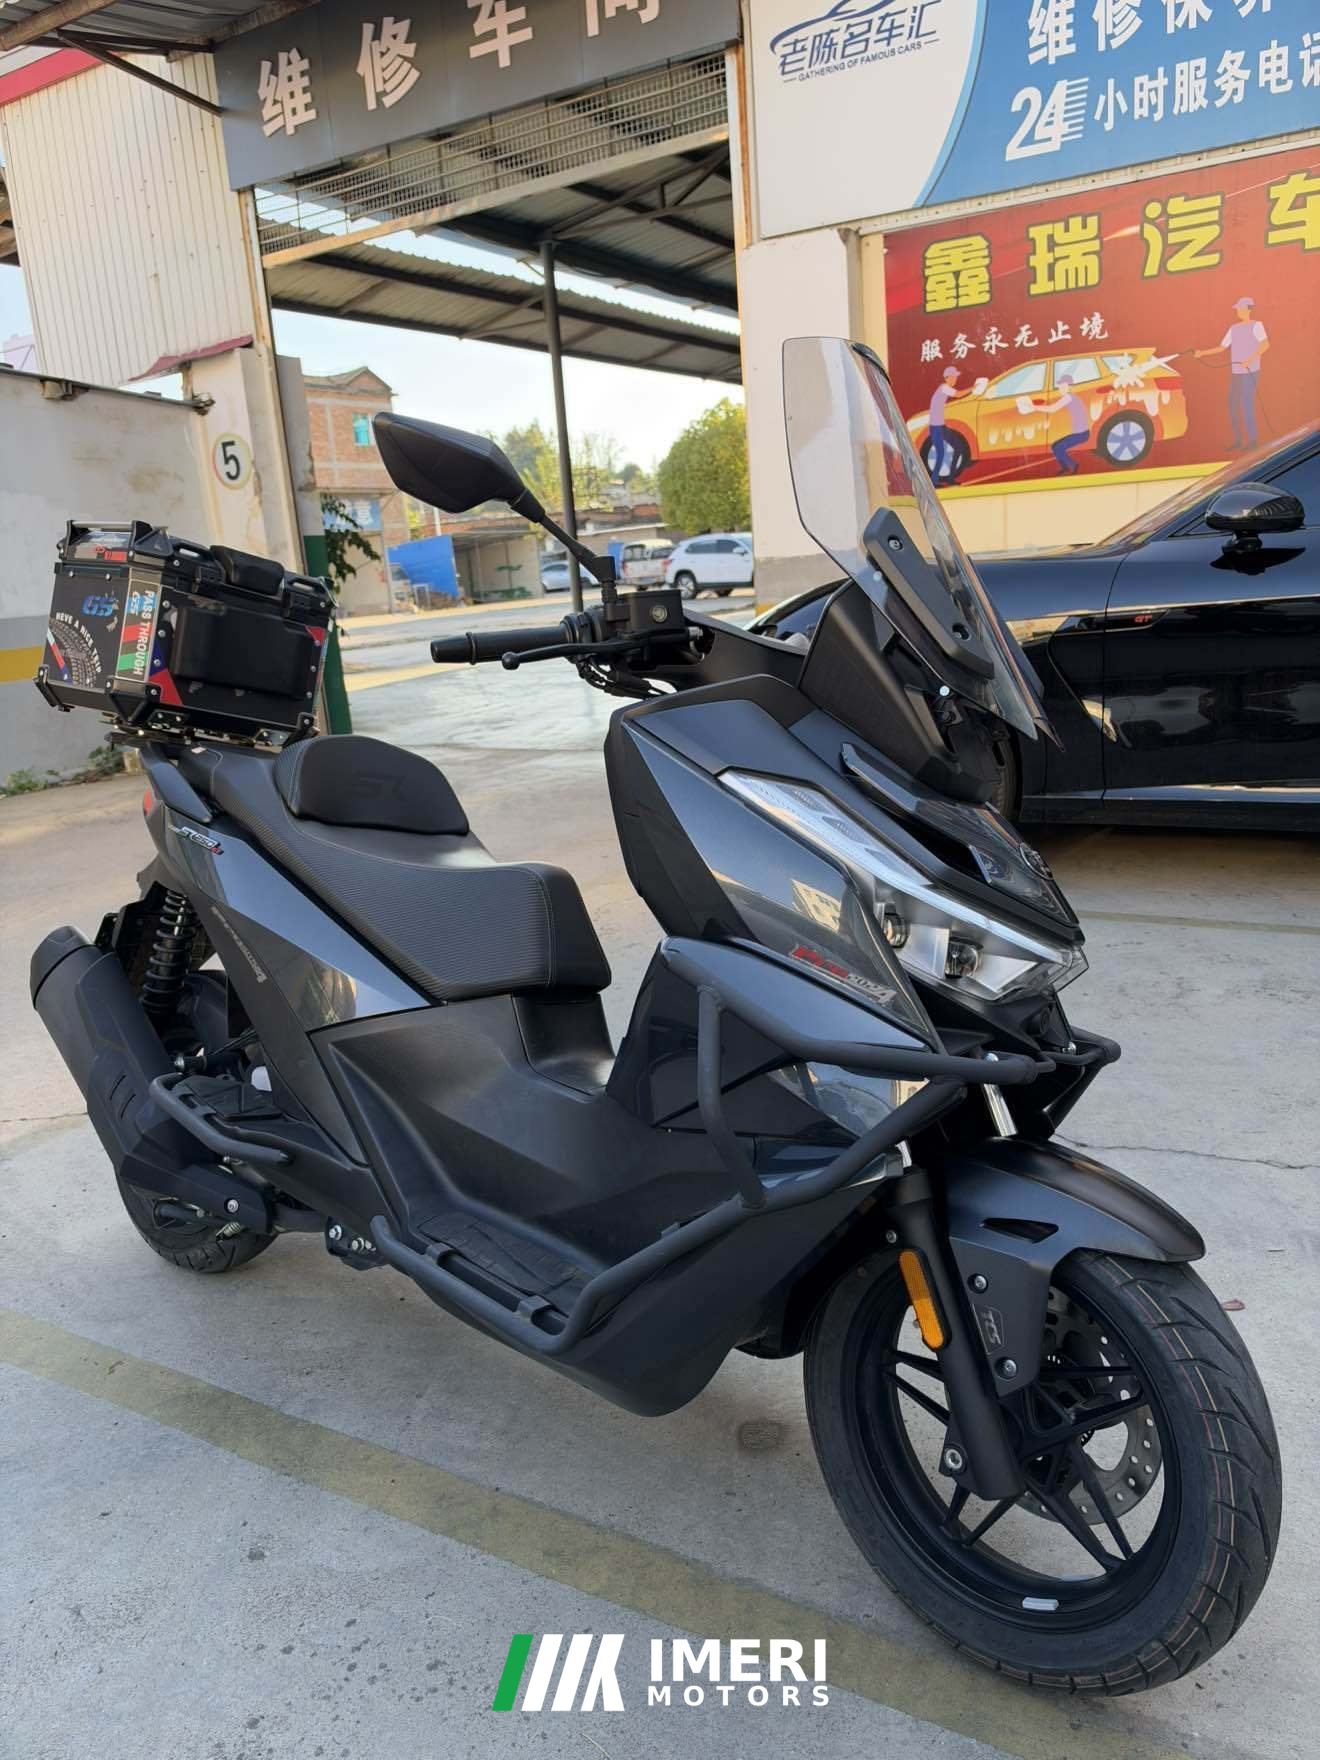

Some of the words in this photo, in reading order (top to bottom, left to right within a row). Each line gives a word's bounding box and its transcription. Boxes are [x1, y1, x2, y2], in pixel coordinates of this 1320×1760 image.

[779, 0, 941, 76] 老陈名车汇
[798, 62, 846, 82] GATHERING
[847, 57, 860, 69] OF
[860, 48, 896, 65] FAMOUS
[897, 41, 922, 56] CARS
[920, 312, 1109, 362] 服务永无止境
[221, 440, 240, 480] 5
[74, 619, 79, 630] A
